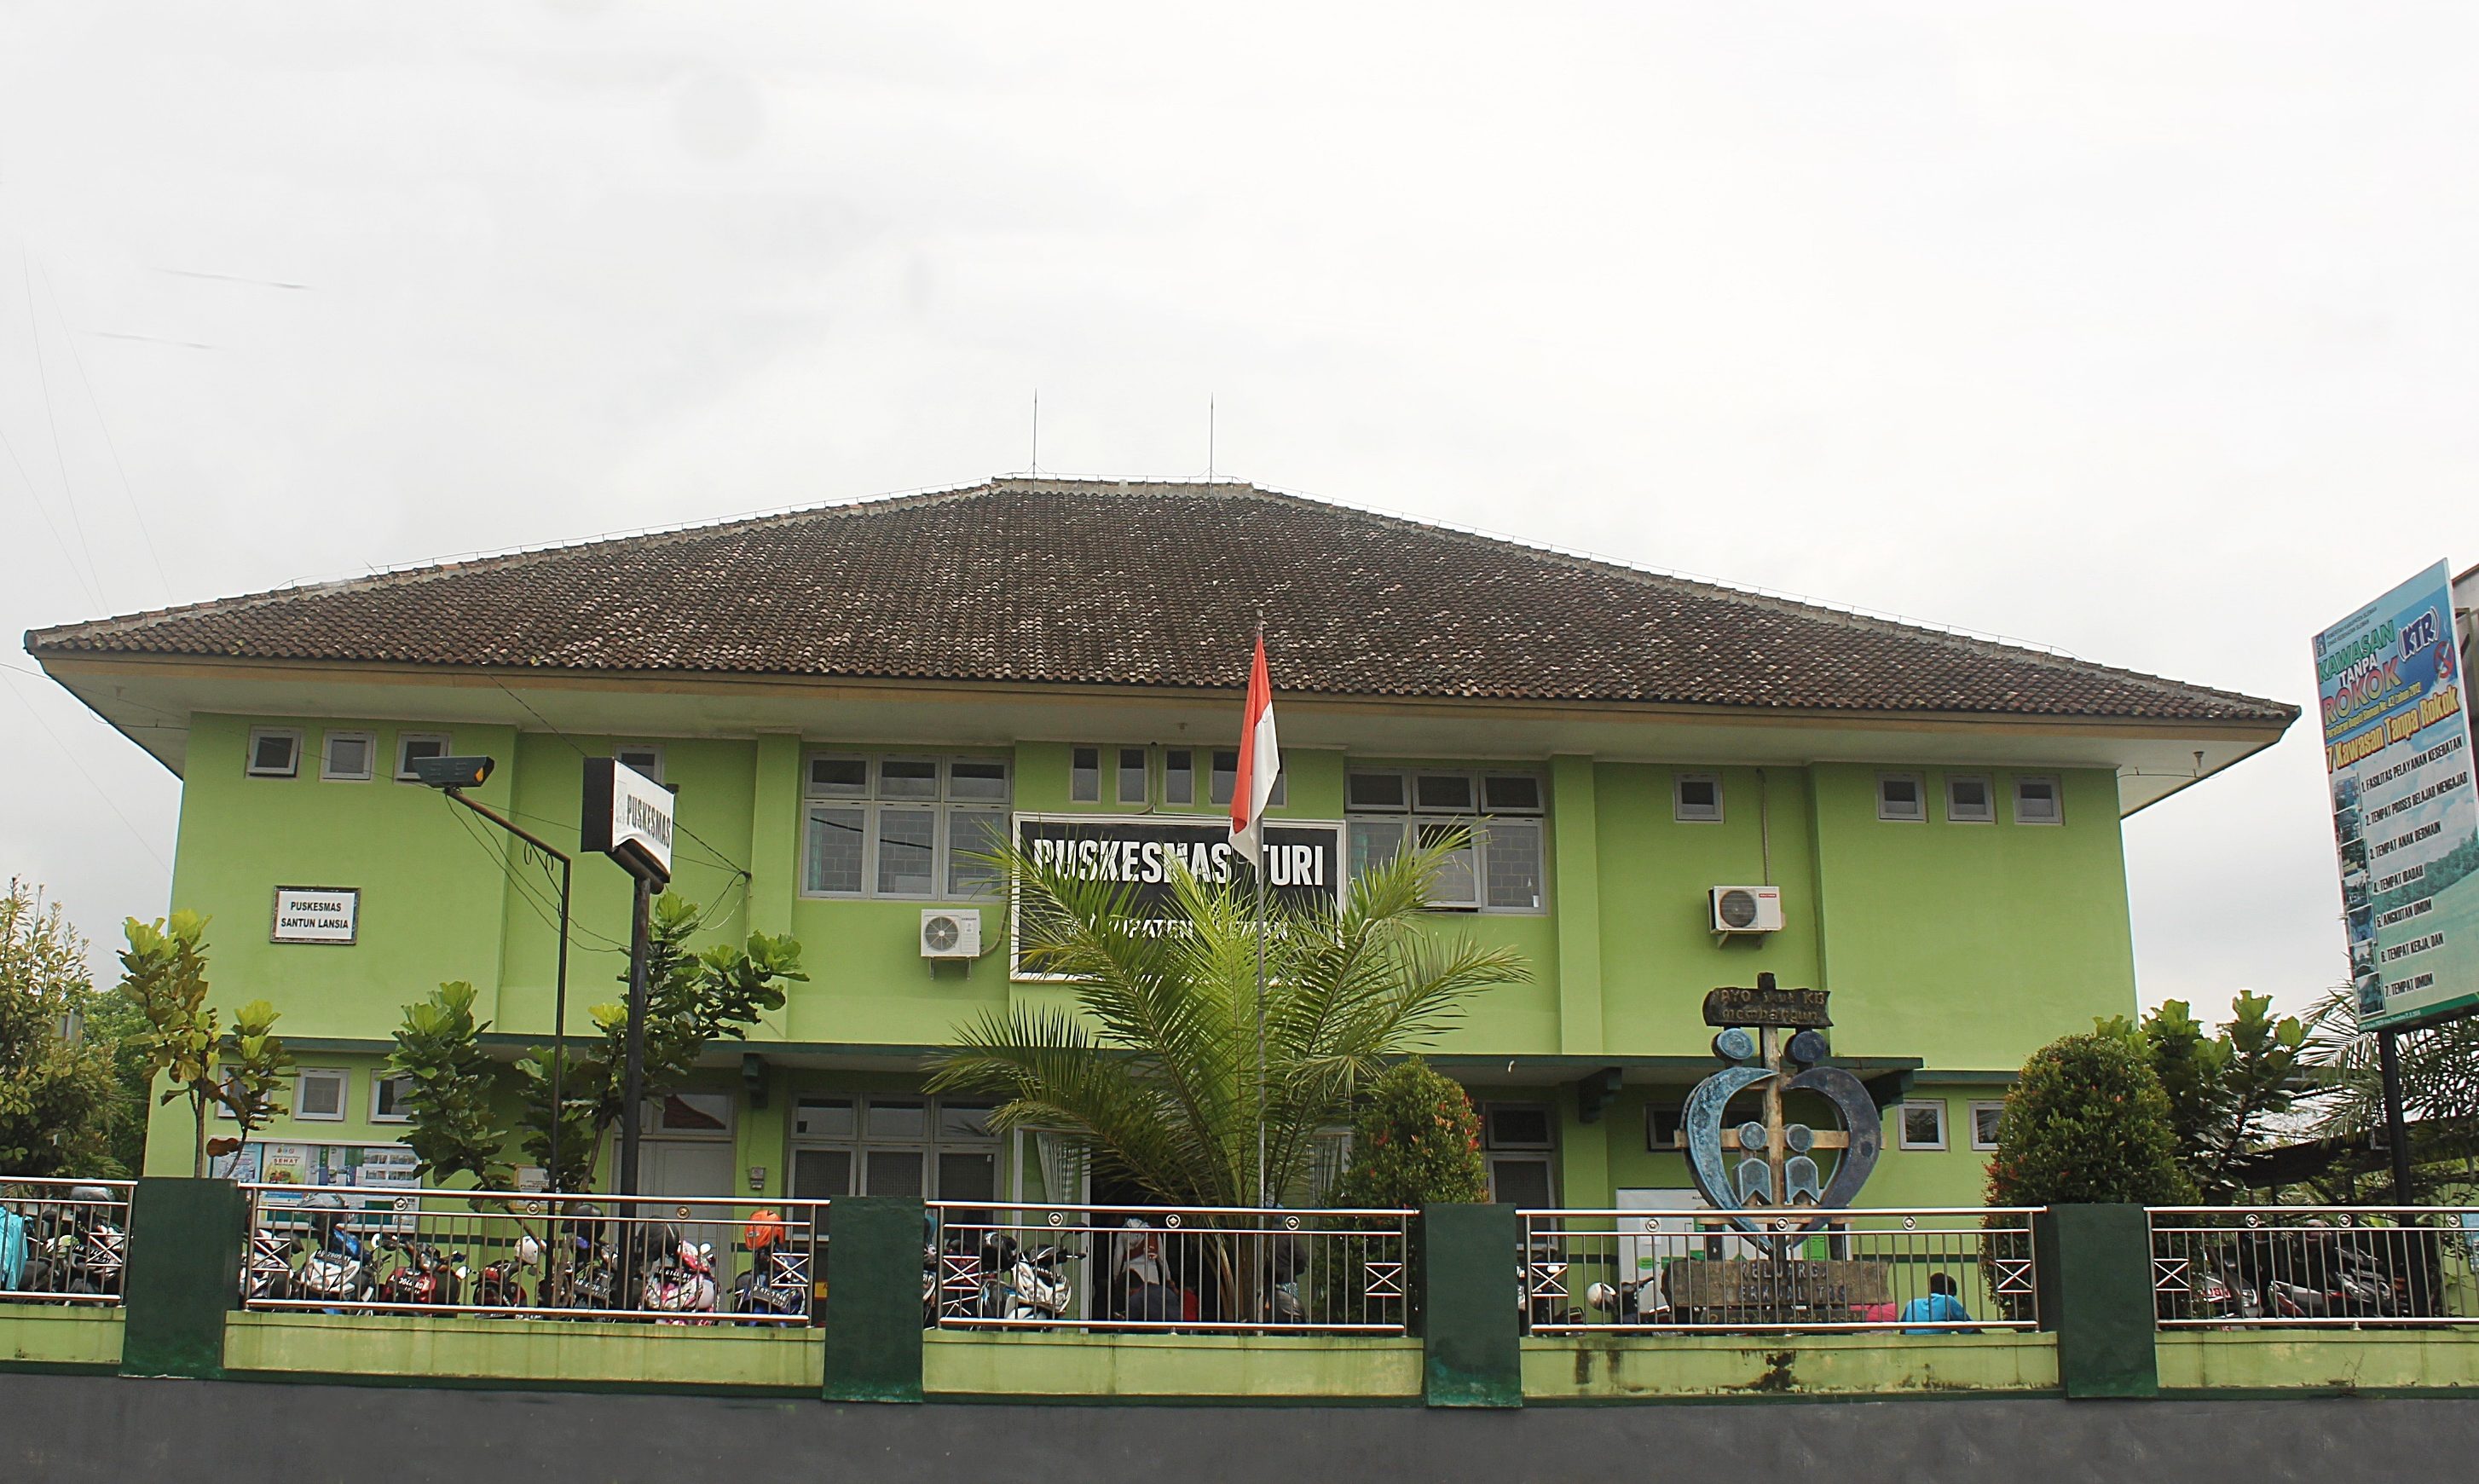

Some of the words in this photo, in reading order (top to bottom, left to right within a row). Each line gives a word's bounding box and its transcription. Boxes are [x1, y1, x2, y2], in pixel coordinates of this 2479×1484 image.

[2318, 620, 2395, 684] KAWASAN
[2340, 651, 2378, 687] TANPA
[2323, 655, 2402, 725] ROKOK
[2326, 745, 2336, 773] 7
[2336, 725, 2385, 770] Kawasan
[2384, 711, 2420, 744] Tanpa
[2419, 685, 2460, 727] Rokok
[2366, 766, 2393, 792] FASILITAS
[2393, 753, 2428, 779] PELAYANAN
[2428, 736, 2462, 765] KESEHATAN
[2371, 803, 2391, 823] TEMPAT
[2392, 794, 2412, 816] PROSES
[2412, 785, 2436, 810] BELAJAR
[2436, 771, 2468, 798] MENGAJAR
[627, 794, 671, 849] PUSKESMAS
[2375, 837, 2397, 857] TEMPAT
[2398, 830, 2414, 849] ANAK
[2414, 820, 2441, 842] BERMAIN
[1034, 839, 1232, 884] PUSKESMAS
[1256, 844, 1323, 886] TURI
[2379, 872, 2401, 892] TEMPAT
[2402, 864, 2424, 885] IBADAH
[280, 918, 315, 927] SANTUN
[318, 919, 349, 929] LANSIA
[291, 901, 341, 912] PUSKESMAS
[2383, 904, 2413, 926] ANGKUTAN
[2413, 898, 2432, 917] UMUM
[2386, 942, 2409, 962] TEMPAT
[2430, 932, 2443, 948] DAN
[1720, 990, 1751, 1003] AYO
[1802, 991, 1824, 1004] KB
[2391, 978, 2413, 996] TEMPAT
[2414, 973, 2433, 990] UMUM
[1741, 1263, 1828, 1279] KELURG
